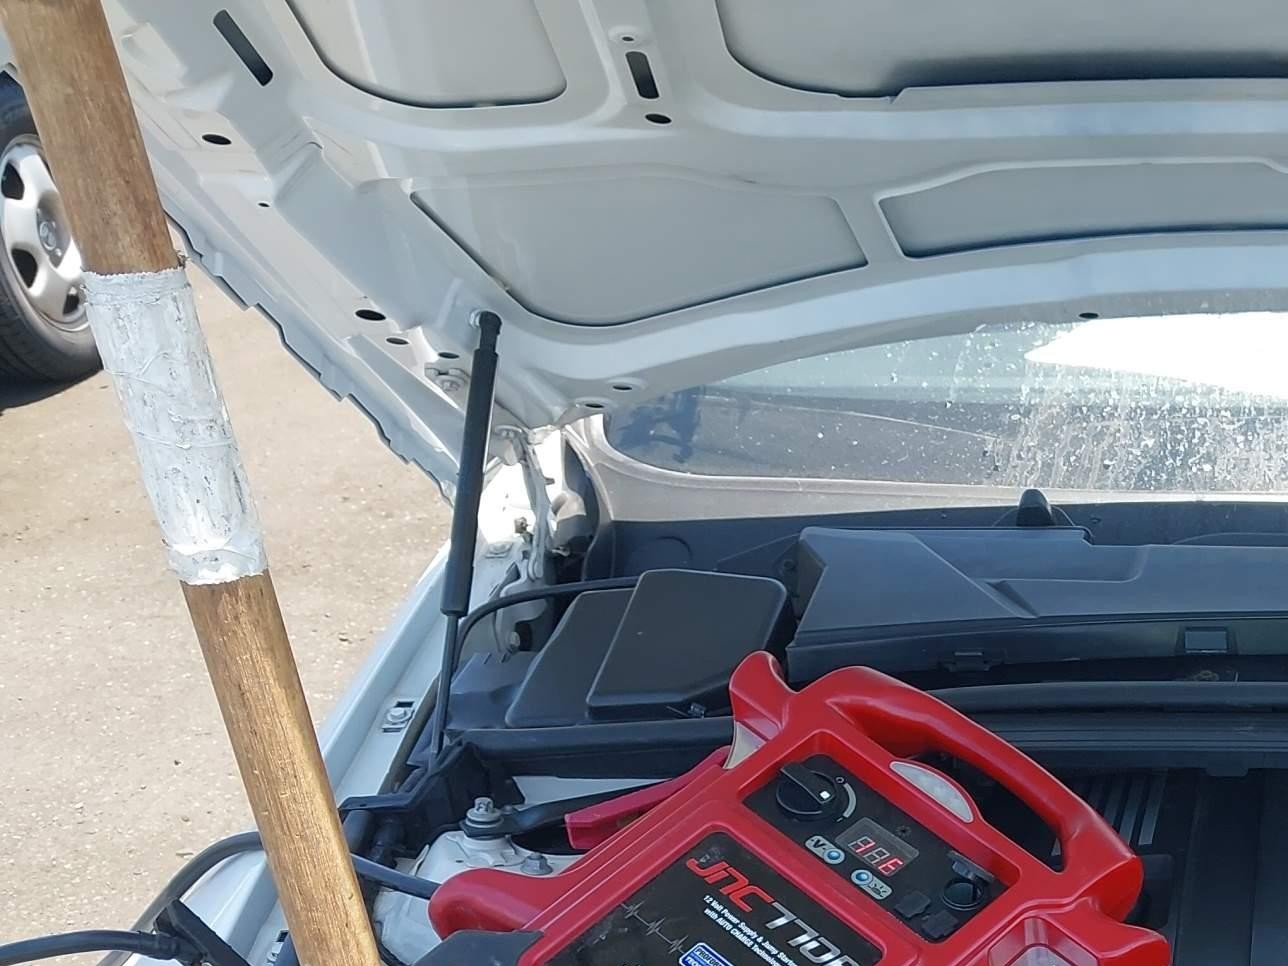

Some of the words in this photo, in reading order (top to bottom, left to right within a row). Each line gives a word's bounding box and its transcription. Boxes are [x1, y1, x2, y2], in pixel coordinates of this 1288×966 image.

[703, 895, 713, 904] 12
[710, 900, 724, 912] Volt
[720, 908, 740, 926] Power
[737, 921, 759, 941] Supply
[760, 940, 780, 957] Jump
[704, 908, 718, 920] with
[716, 917, 732, 931] AUTO
[730, 928, 754, 948] CHARGE
